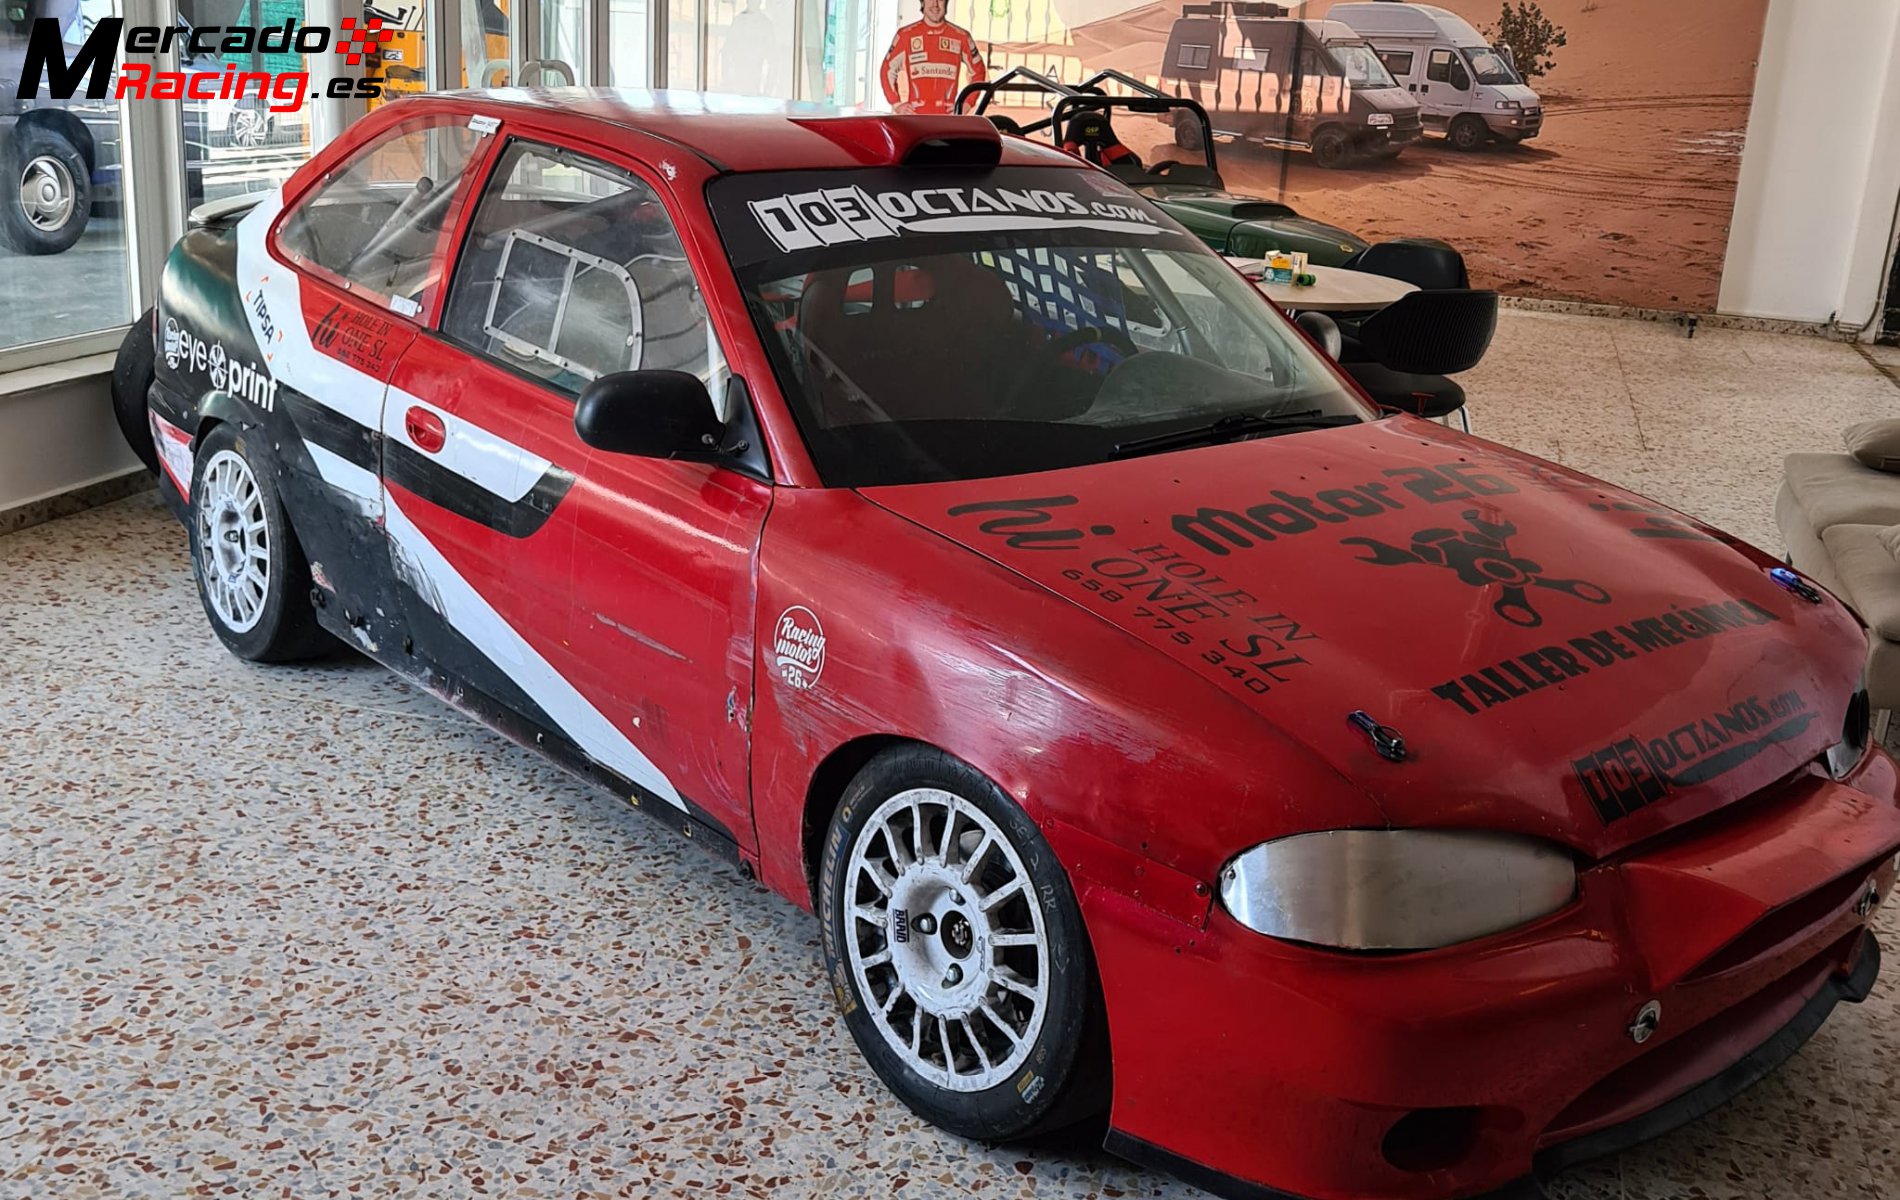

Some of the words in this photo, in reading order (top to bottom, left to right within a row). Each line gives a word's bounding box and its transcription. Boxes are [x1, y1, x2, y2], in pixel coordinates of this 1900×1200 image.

[253, 288, 275, 344] TIPSA
[352, 311, 380, 332] HOLE
[341, 327, 372, 353] ONE
[368, 339, 388, 361] SL
[227, 358, 278, 413] print
[1090, 556, 1230, 625] ONE
[1219, 632, 1313, 684] SL
[1128, 542, 1258, 609] HOLE
[1251, 611, 1321, 645] IN
[781, 617, 826, 660] Racing
[1061, 568, 1125, 604] 658
[1132, 606, 1195, 646] 775
[1201, 650, 1272, 695] 340
[787, 666, 802, 688] 26
[1430, 645, 1591, 716] TALLER
[1567, 629, 1638, 668] DE
[822, 826, 843, 957] MICHELIN
[894, 909, 908, 943] BRAID
